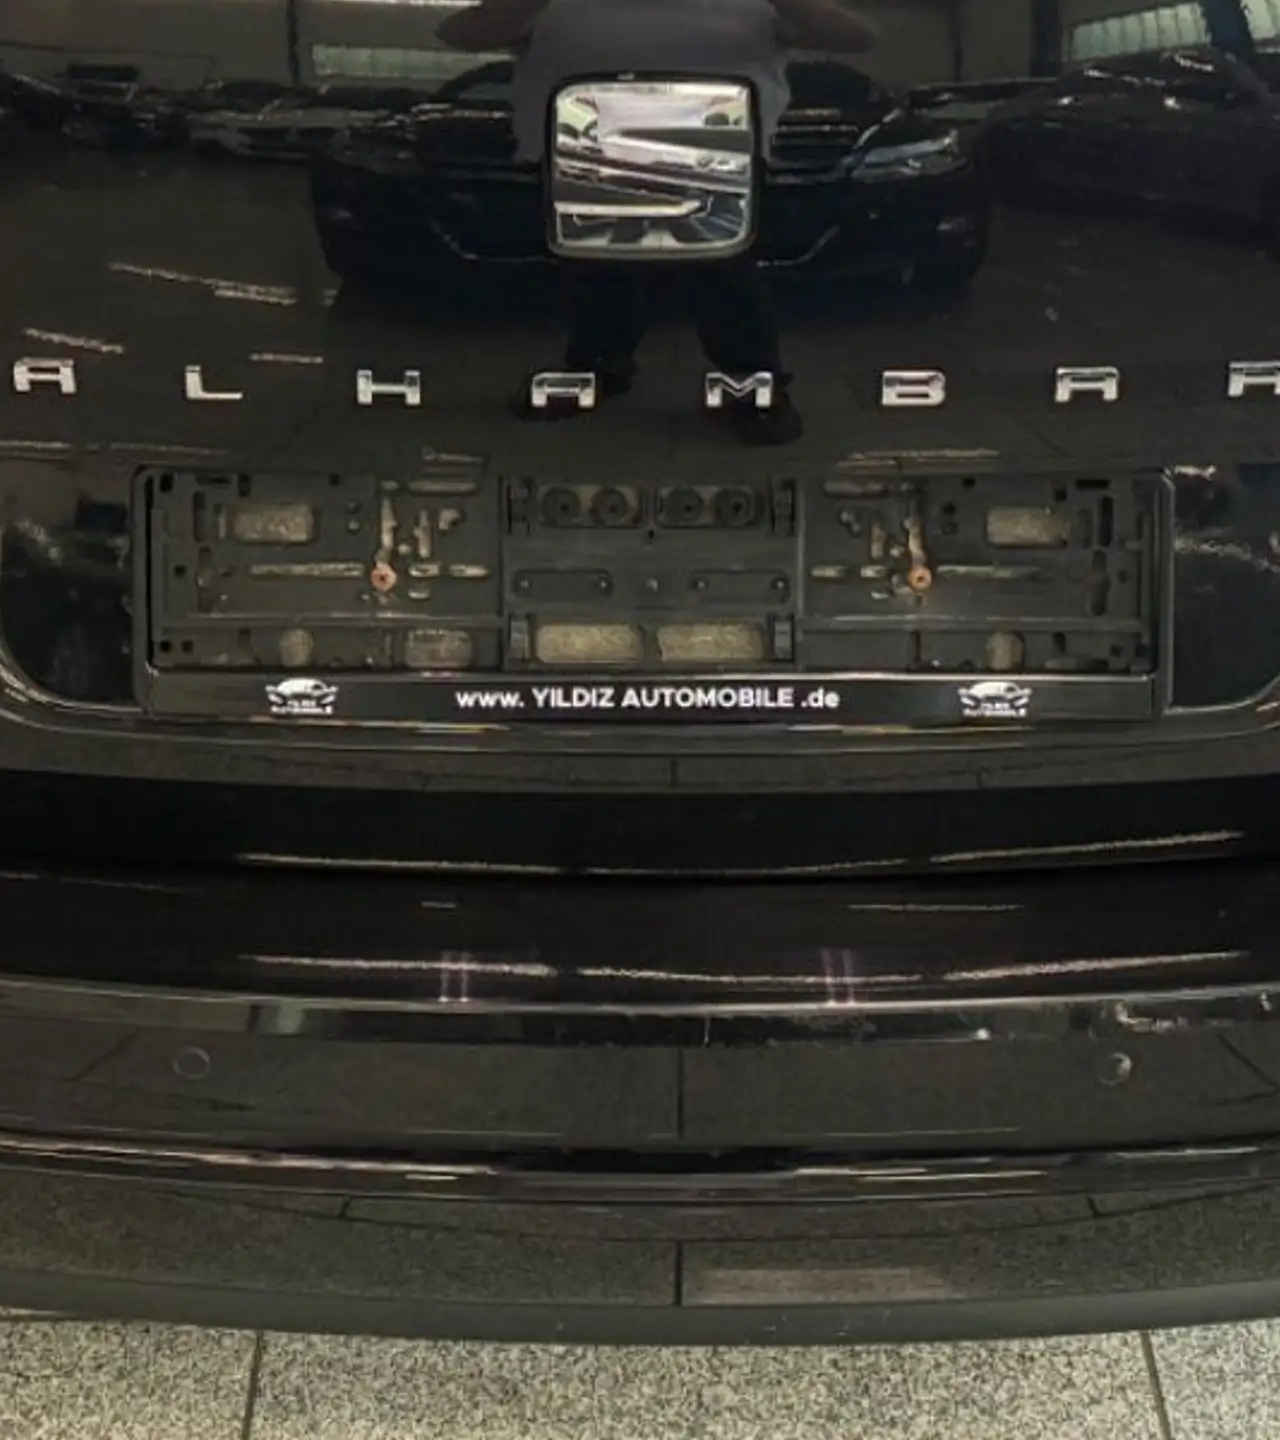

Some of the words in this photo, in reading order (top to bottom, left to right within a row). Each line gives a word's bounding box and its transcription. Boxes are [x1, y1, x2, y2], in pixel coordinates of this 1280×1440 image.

[455, 689, 524, 708] www.
[532, 687, 614, 708] YILDIZ
[621, 687, 795, 709] AUTOMOBILE
[800, 687, 840, 709] .de
